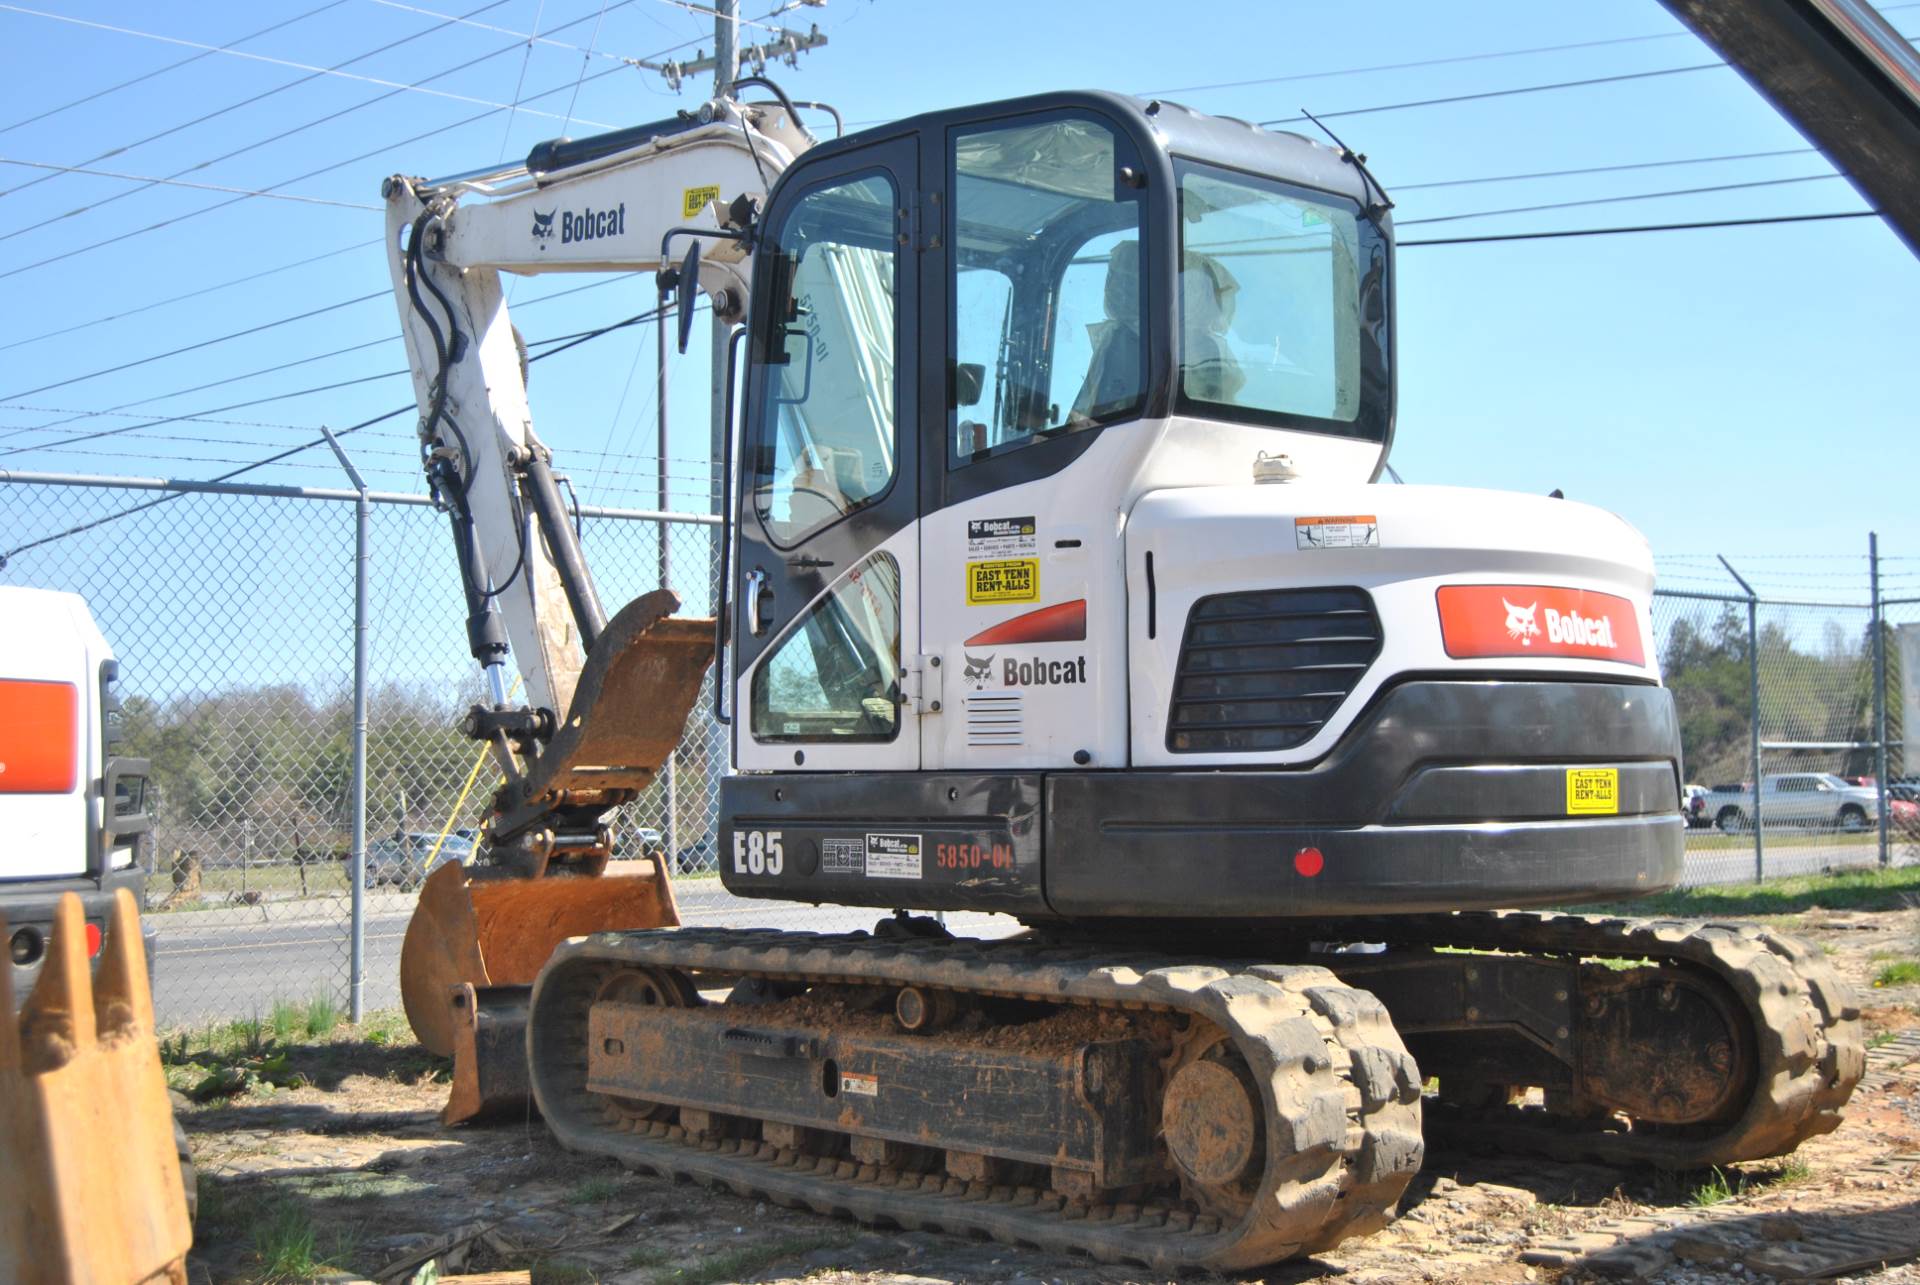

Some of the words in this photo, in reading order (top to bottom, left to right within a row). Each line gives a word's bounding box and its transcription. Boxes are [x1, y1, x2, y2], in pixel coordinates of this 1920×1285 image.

[561, 203, 625, 244] Bobcat
[983, 521, 1010, 532] Bobcat
[976, 570, 1001, 581] EAST
[1004, 568, 1030, 579] TENN
[976, 579, 1030, 592] RENT-ALLS
[1544, 608, 1614, 648] Bobcat
[1003, 656, 1086, 686] Bobcat
[1576, 779, 1593, 788] EAST
[1595, 778, 1612, 788] TENN
[1576, 789, 1612, 800] RENT-ALLS
[733, 831, 784, 875] E85
[937, 844, 1011, 868] 5850-01
